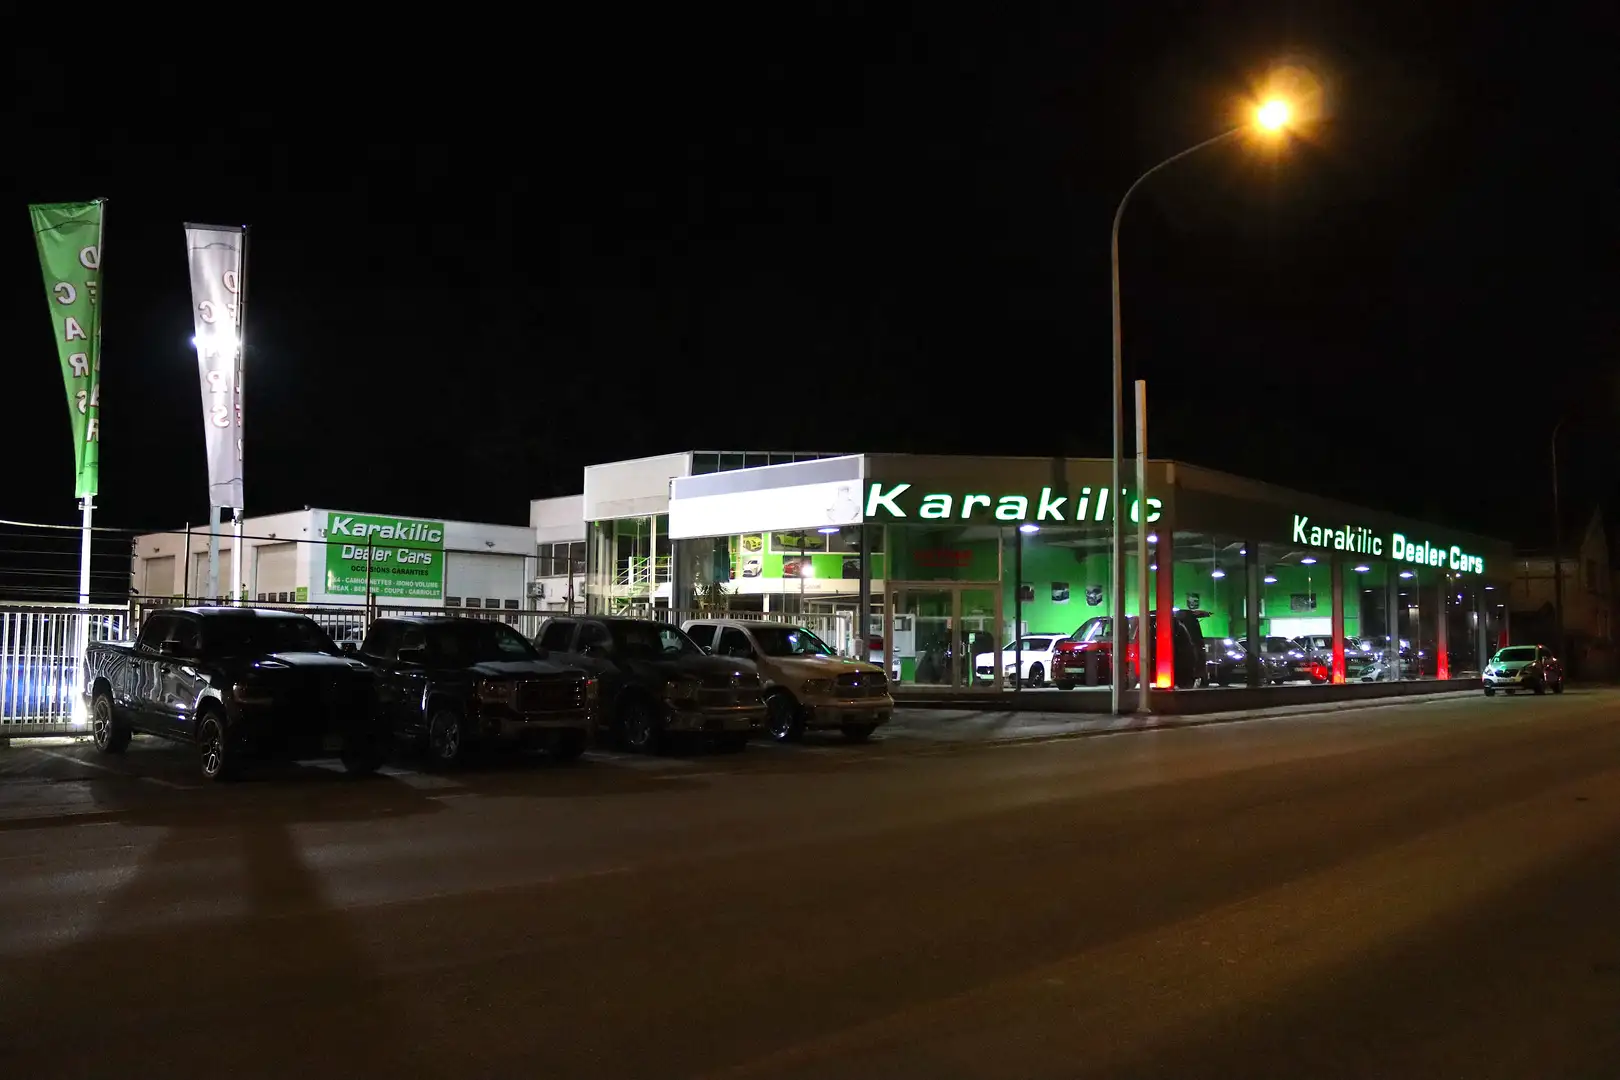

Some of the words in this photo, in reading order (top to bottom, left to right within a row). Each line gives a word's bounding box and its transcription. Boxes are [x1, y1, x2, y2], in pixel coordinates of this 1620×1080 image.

[331, 516, 441, 542] Karakilic
[397, 548, 432, 565] Cars
[1293, 515, 1382, 555] Karakilic
[1391, 532, 1447, 568] Dealer
[1449, 545, 1484, 574] Cars
